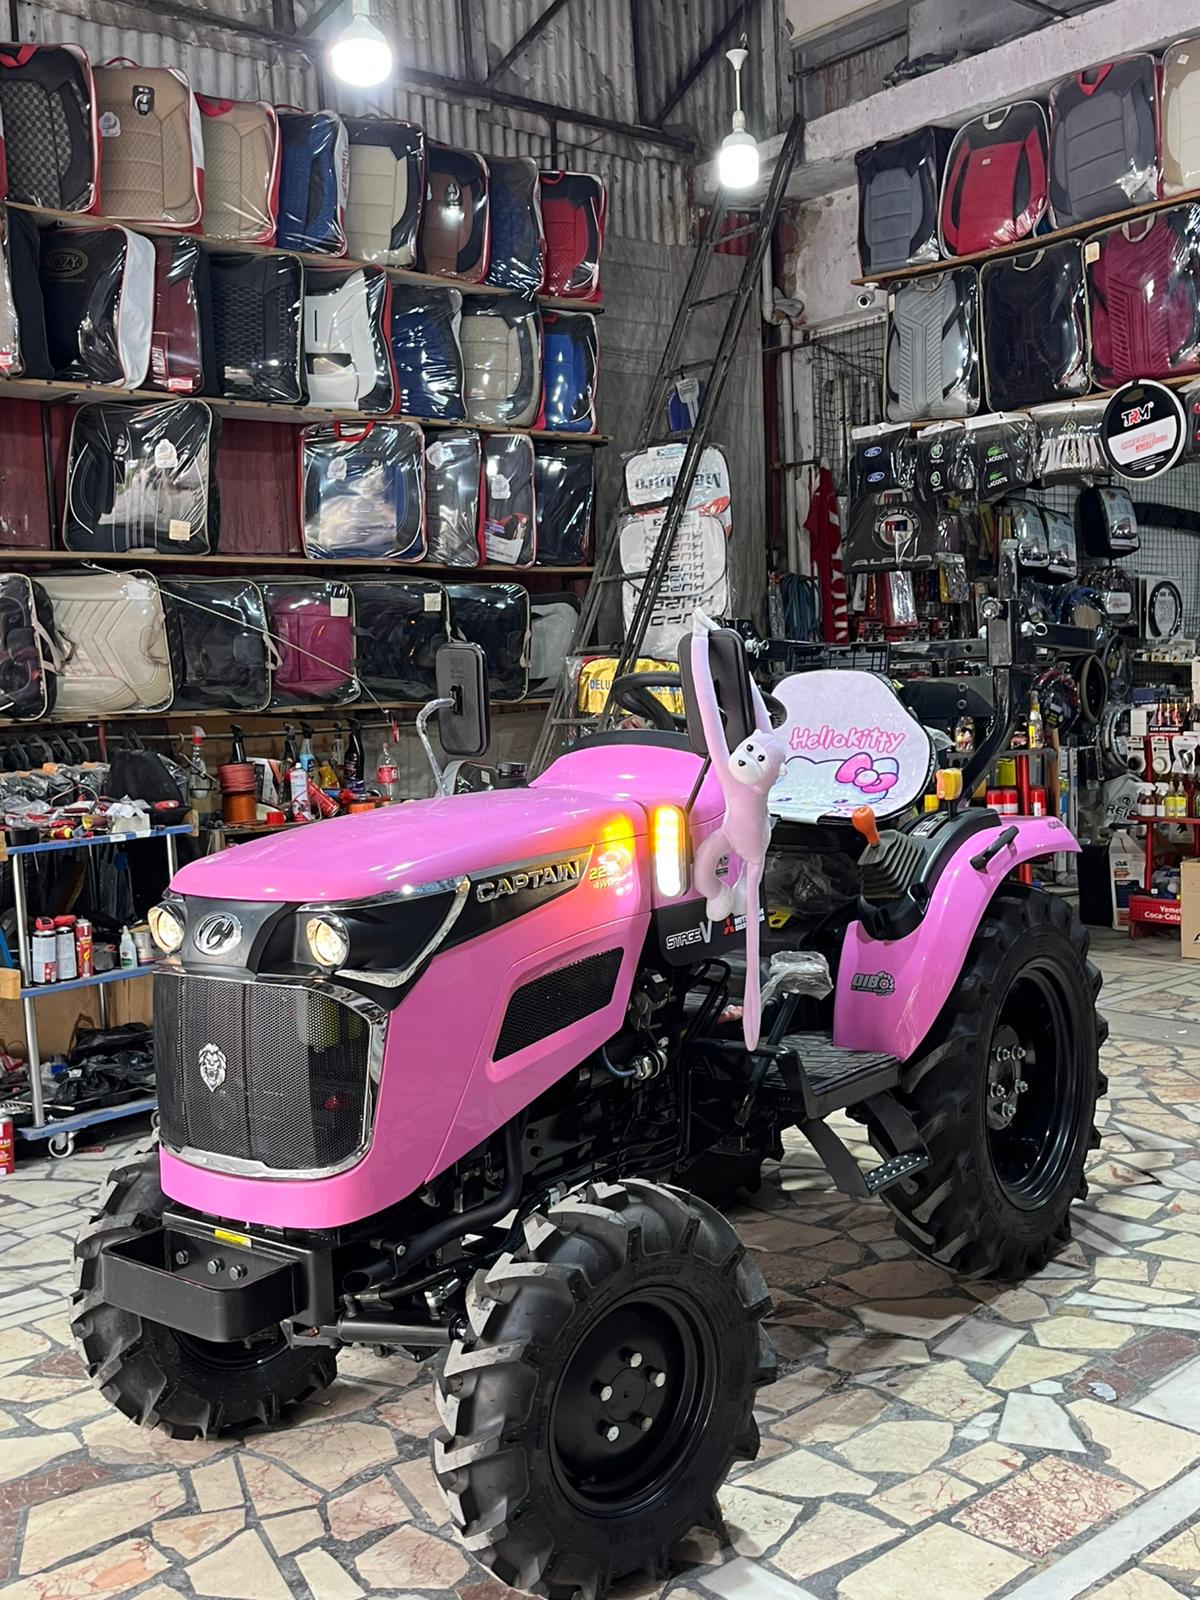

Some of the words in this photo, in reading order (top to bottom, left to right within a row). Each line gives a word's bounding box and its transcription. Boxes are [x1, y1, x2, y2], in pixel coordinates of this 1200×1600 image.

[985, 453, 1009, 463] LACOSTE
[987, 477, 1008, 488] LACOSTE
[589, 679, 613, 690] DELU
[475, 860, 580, 904] CAPTAIN
[1144, 911, 1181, 921] Coca-Cola
[666, 928, 703, 950] STAGE
